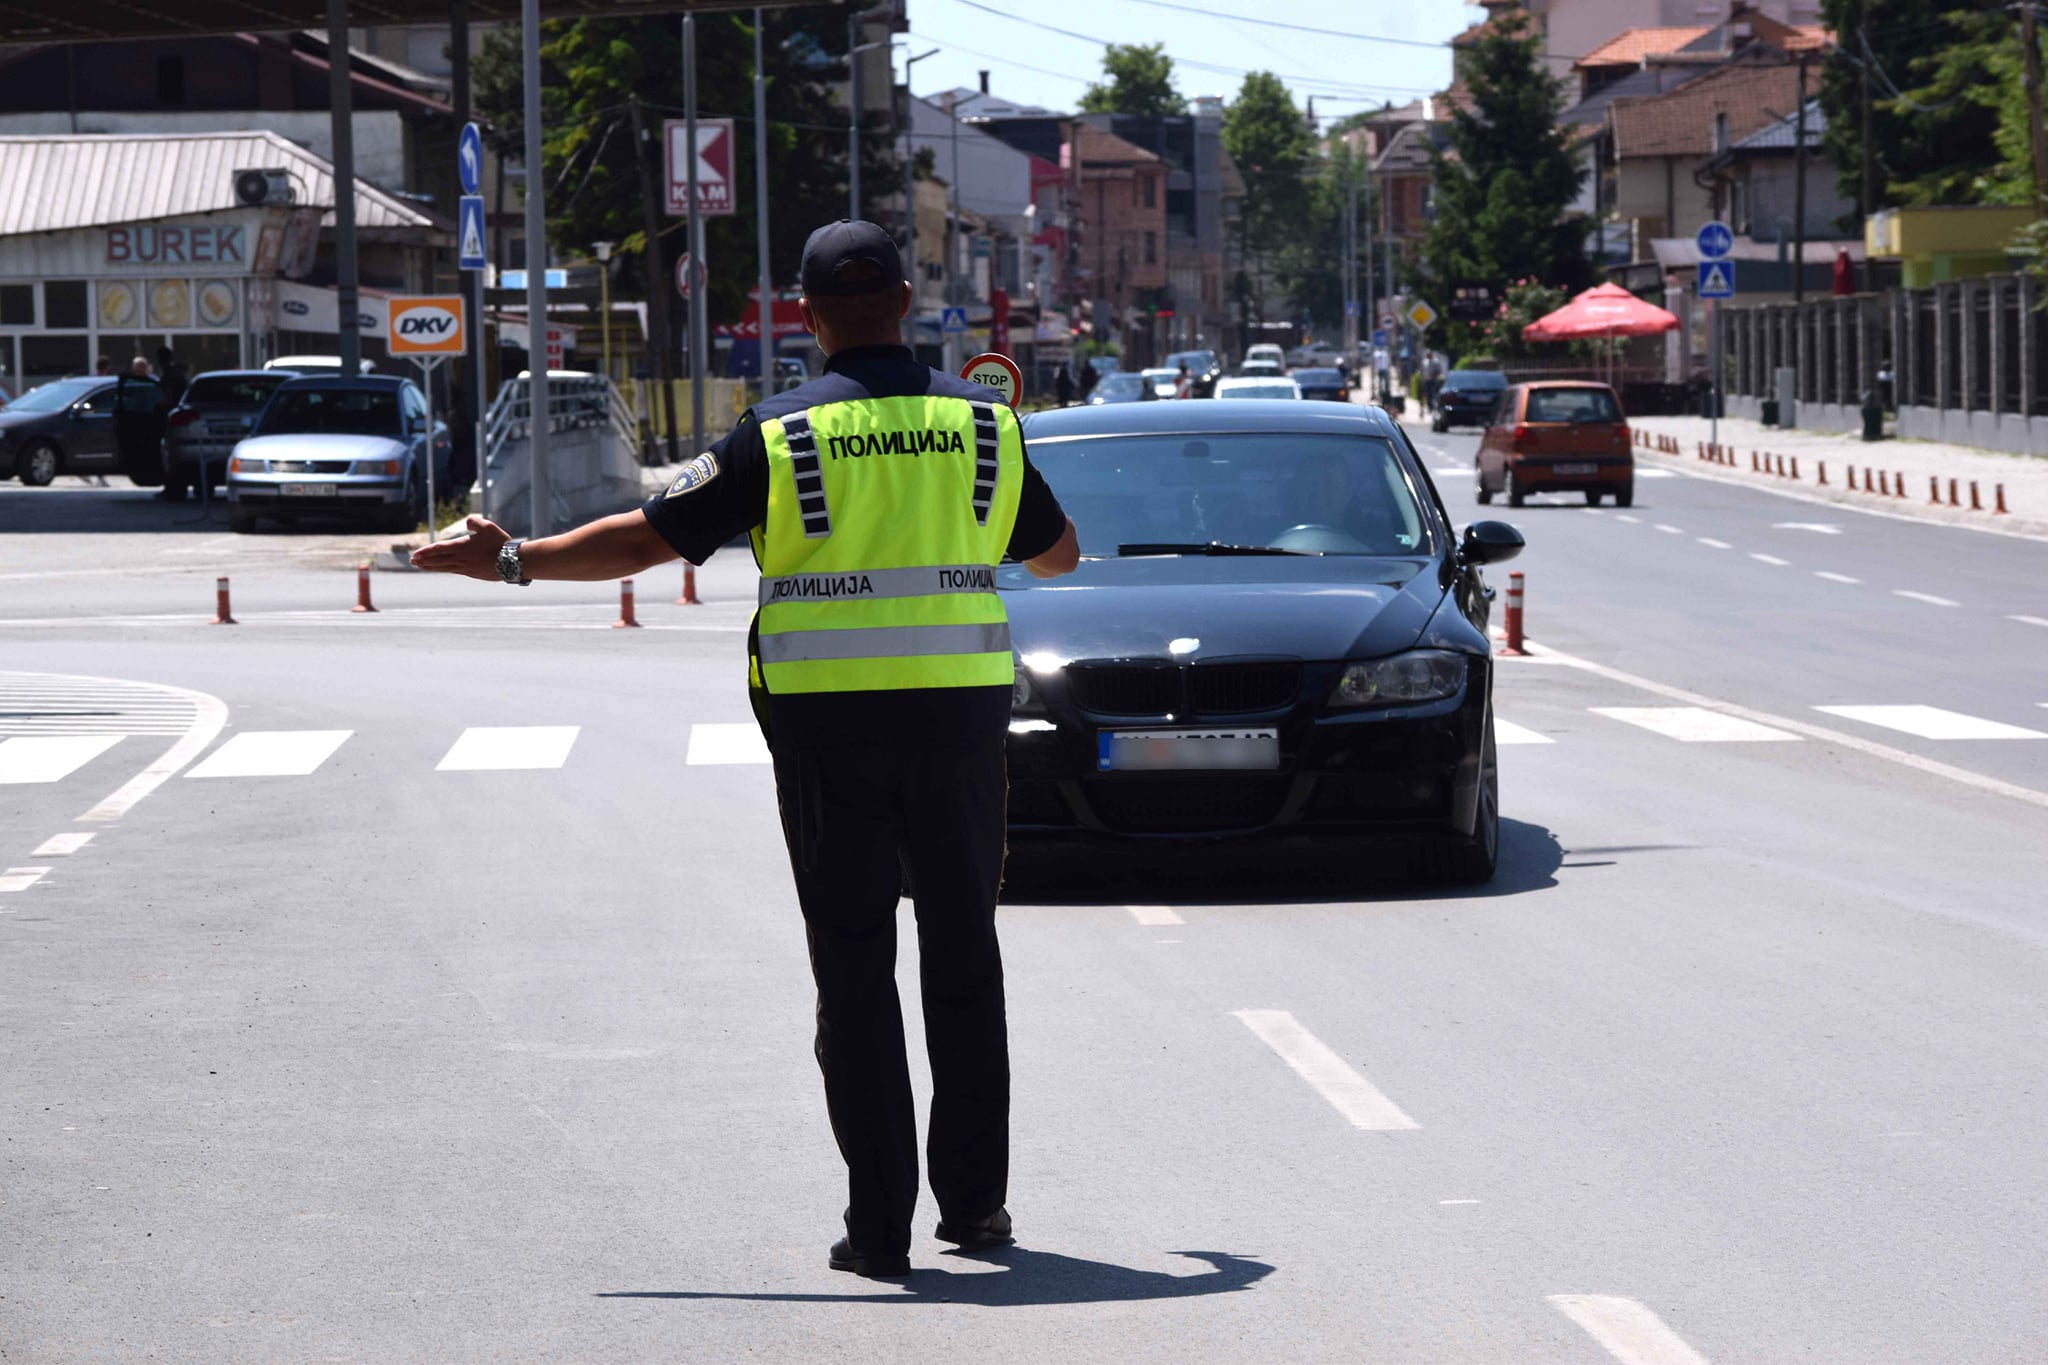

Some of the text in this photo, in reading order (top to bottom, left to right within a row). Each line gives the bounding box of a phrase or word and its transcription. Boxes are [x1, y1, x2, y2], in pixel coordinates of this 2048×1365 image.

[107, 228, 240, 261] BUREK
[400, 317, 453, 334] DKV
[973, 373, 1008, 386] STOP
[828, 429, 966, 460] ПОЛИЦИЈА
[772, 575, 874, 599] ПОЛИЦИЈА
